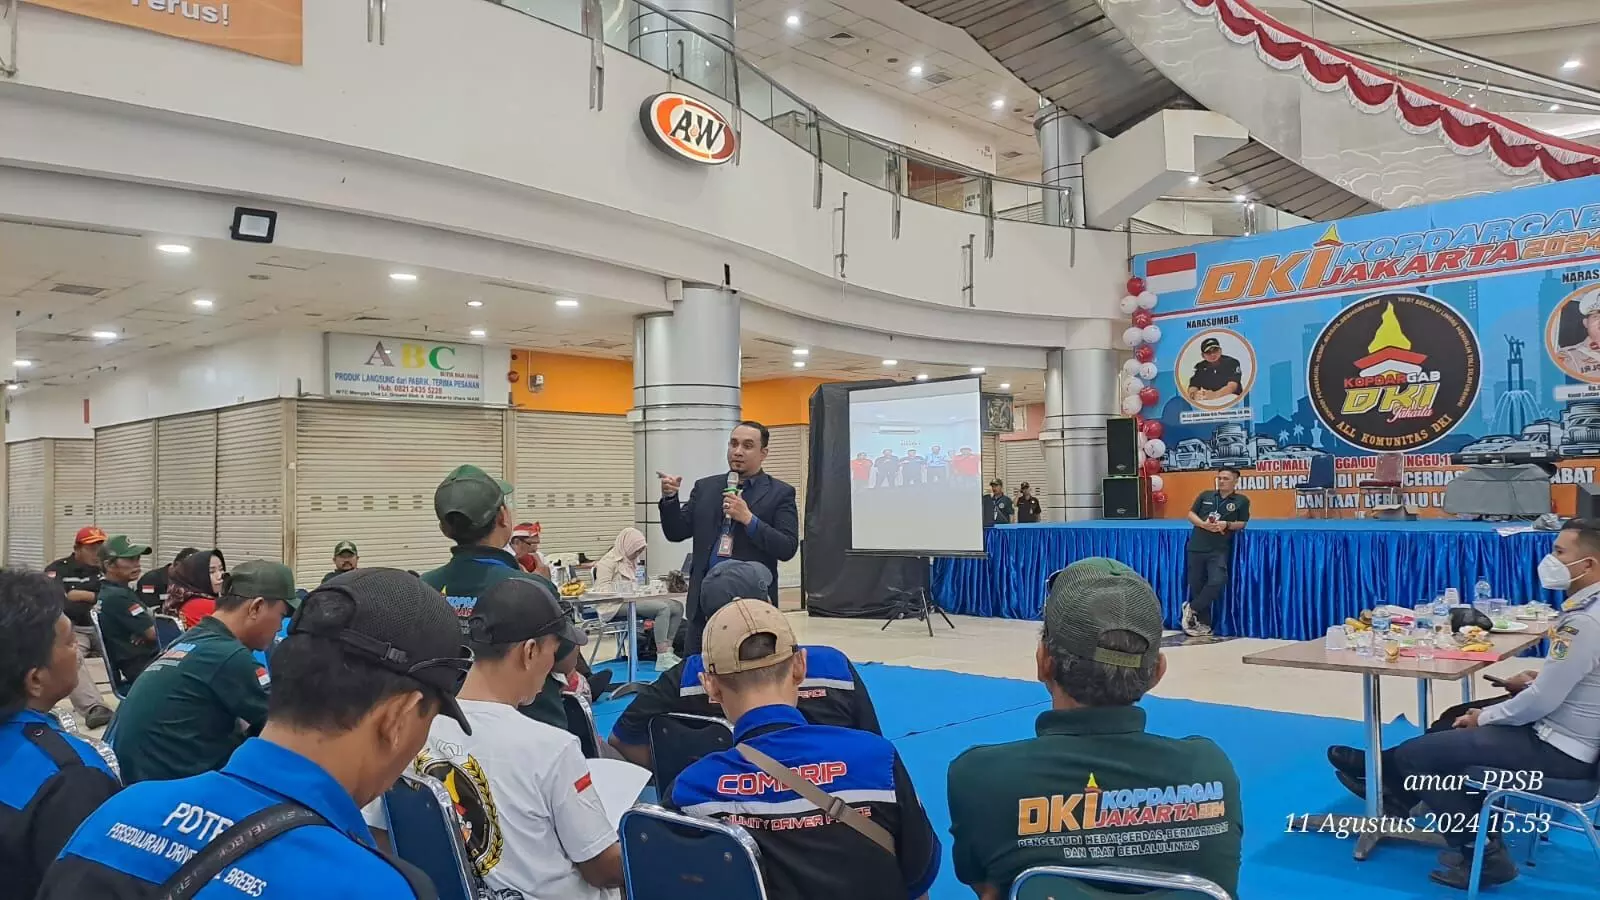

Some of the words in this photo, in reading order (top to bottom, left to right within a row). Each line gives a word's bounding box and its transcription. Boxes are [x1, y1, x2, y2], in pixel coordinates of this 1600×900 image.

[132, 0, 230, 26] erus!
[1336, 203, 1600, 264] KOPDARGAB
[1321, 240, 1520, 287] JAKARTA
[1520, 230, 1600, 260] 2024
[1194, 246, 1335, 306] DKI
[1186, 314, 1239, 329] NARASUMBER
[335, 372, 360, 381] PRODUK
[362, 374, 395, 383] LANGSUNG
[454, 380, 480, 389] PESANAN
[1344, 370, 1441, 388] KOPDARGAB
[1341, 382, 1440, 414] DKI
[1336, 420, 1356, 438] ALL
[1361, 429, 1429, 447] KOMUNITAS
[1432, 414, 1453, 432] DKI
[1256, 460, 1279, 472] WTC
[1282, 459, 1309, 471] MALL
[1361, 456, 1376, 468] DU
[1296, 493, 1324, 508] DAN
[1100, 781, 1224, 811] KOPDARGAB
[771, 815, 824, 831] DRIVER
[1018, 791, 1099, 836] DKI
[1096, 803, 1198, 829] JAKARTA
[1018, 834, 1083, 848] PENGEMUDI
[1063, 848, 1087, 858] DAN
[1089, 846, 1116, 858] TAAT
[223, 867, 268, 898] BREBES
